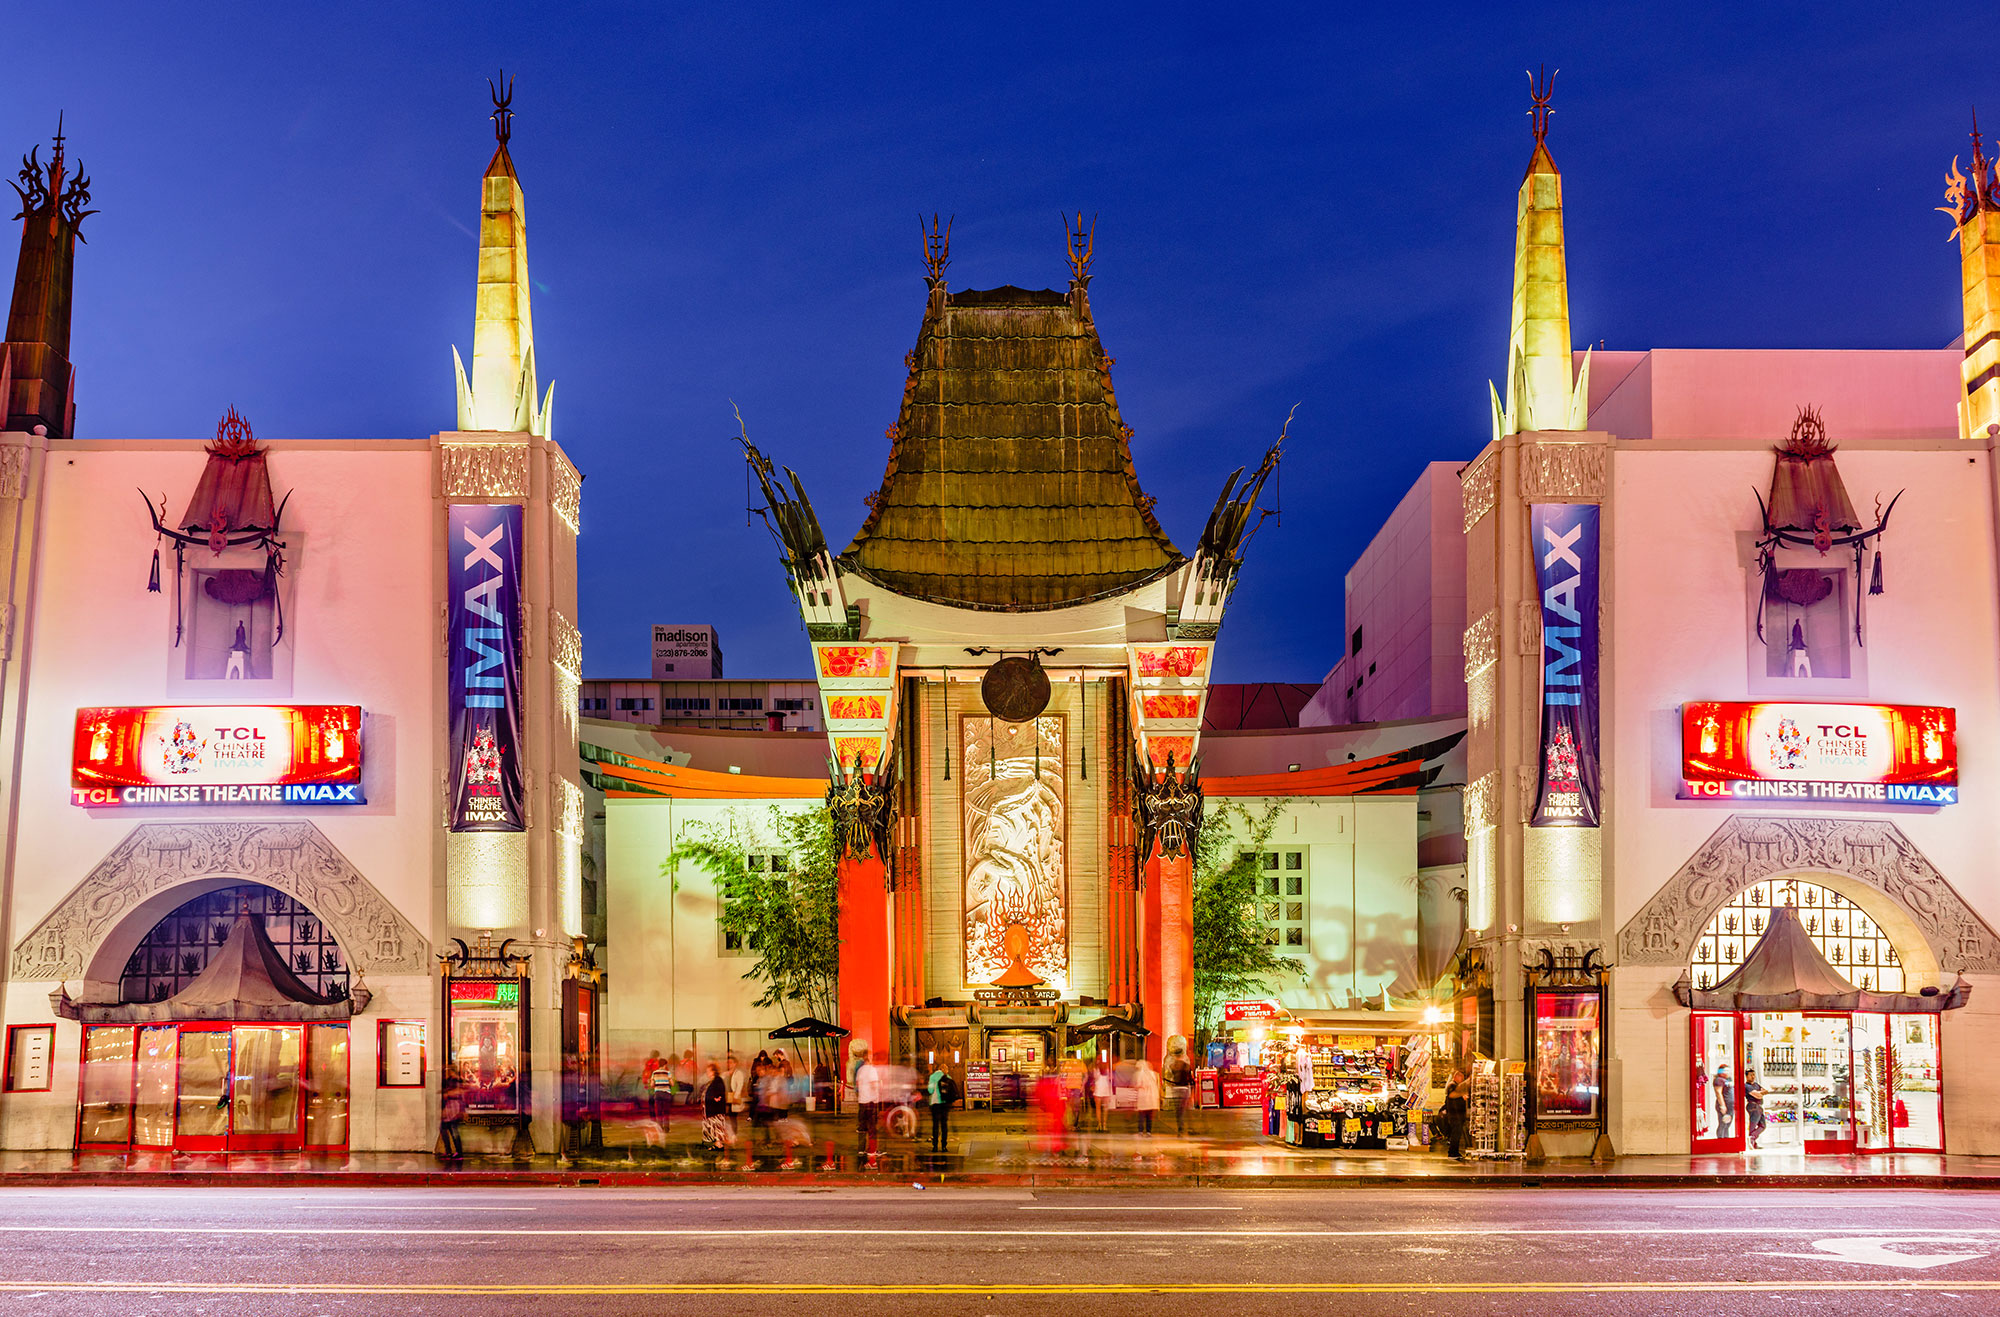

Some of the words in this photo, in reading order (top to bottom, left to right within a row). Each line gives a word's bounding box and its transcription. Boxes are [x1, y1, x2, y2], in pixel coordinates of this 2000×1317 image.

[464, 523, 505, 709] IMAX
[1544, 522, 1582, 706] IMAX
[655, 630, 708, 642] madison
[214, 727, 266, 740] TCL
[1817, 725, 1867, 738] TCL
[213, 742, 266, 751] CHINESE
[1817, 740, 1867, 749] CHINESE
[214, 750, 266, 759] THEATRE
[1818, 748, 1867, 757] THEATRE
[214, 759, 265, 768] IMAX
[1818, 757, 1867, 766] IMAX
[468, 785, 502, 796] TCL
[1548, 781, 1580, 792] TCL
[1688, 781, 1732, 796] TCL
[1734, 781, 1807, 797] CHINESE
[1809, 783, 1885, 800] THEATRE
[1888, 786, 1954, 801] IMAX
[74, 789, 120, 804] TCL
[123, 786, 200, 802] CHINESE
[201, 785, 282, 801] THEATRE
[285, 785, 356, 800] IMAX
[465, 811, 508, 821] IMAX
[1543, 807, 1584, 816] IMAX
